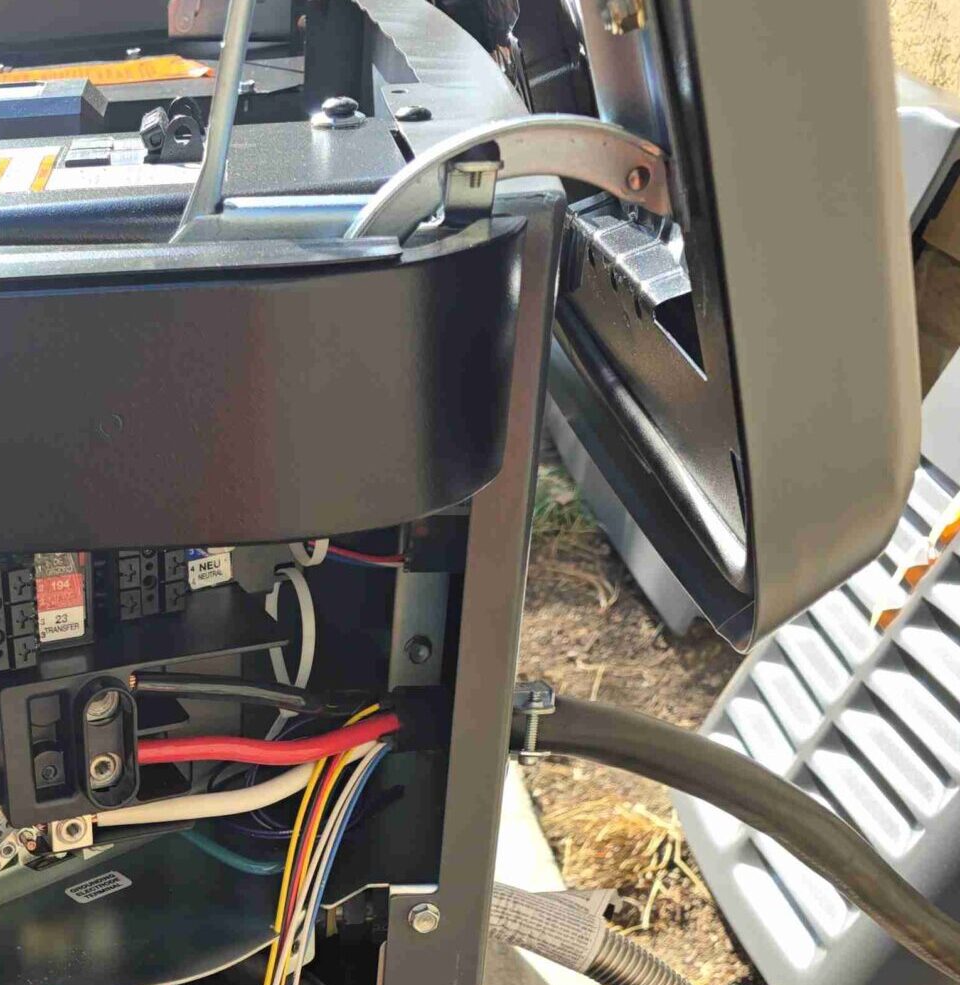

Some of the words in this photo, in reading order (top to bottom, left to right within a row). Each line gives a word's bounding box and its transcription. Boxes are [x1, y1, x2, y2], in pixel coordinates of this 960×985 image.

[199, 560, 221, 572] NEU
[198, 569, 223, 580] NEUTRAL
[51, 580, 70, 592] 194
[55, 614, 68, 625] 23
[45, 622, 80, 634] TRANSFER
